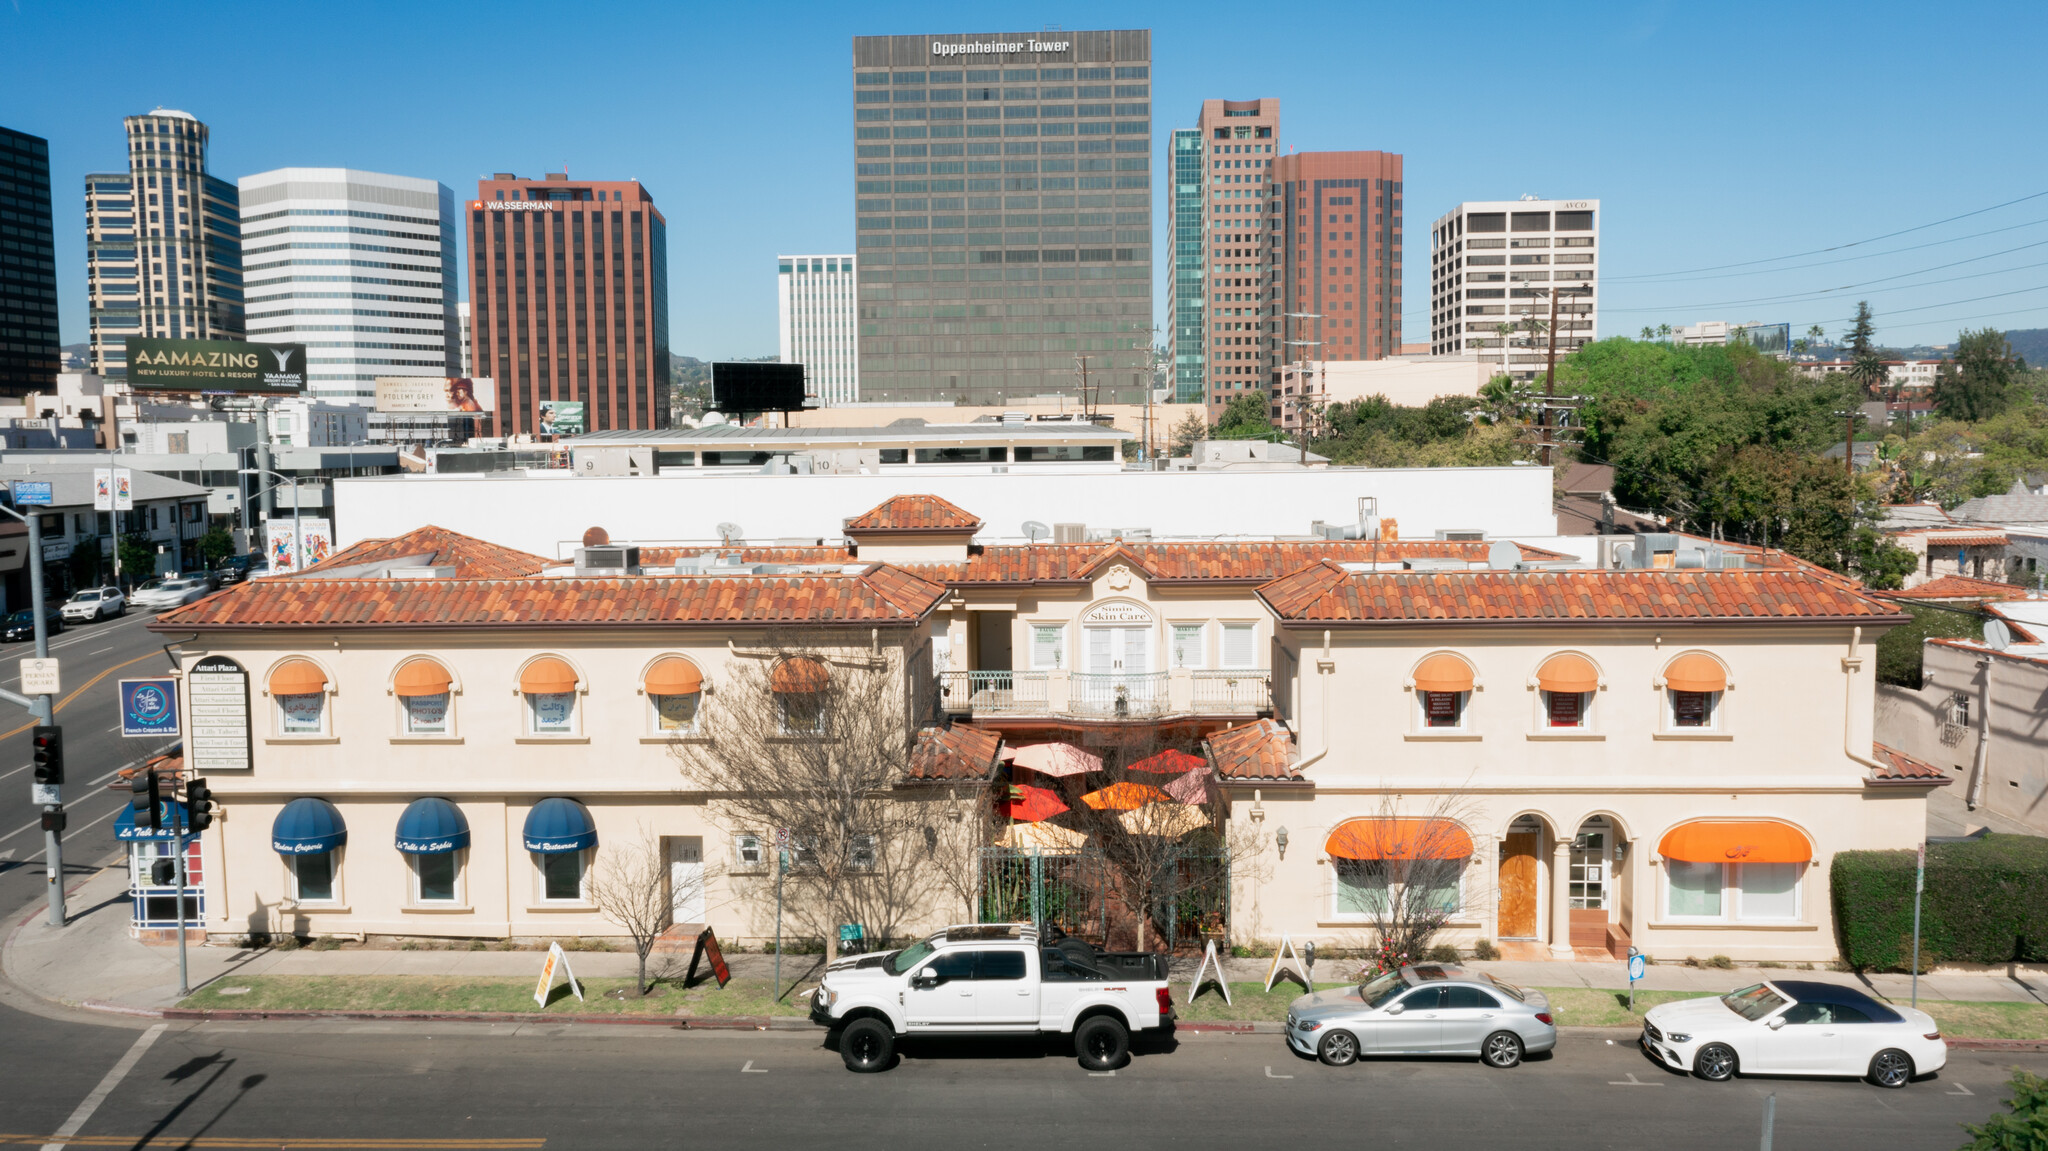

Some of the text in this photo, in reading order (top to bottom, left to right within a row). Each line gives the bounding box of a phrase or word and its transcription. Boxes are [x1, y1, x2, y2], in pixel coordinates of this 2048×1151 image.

[933, 40, 1069, 56] Oppenheimer Tower
[487, 202, 553, 210] WASSERMAN
[135, 350, 258, 368] AAMAZING
[586, 461, 593, 470] 9
[817, 461, 830, 470] 10
[119, 828, 132, 837] La
[134, 827, 153, 837] Tabl
[157, 828, 166, 836] de
[274, 841, 293, 850] Modern
[403, 842, 418, 850] Table
[429, 841, 452, 851] Sophie
[526, 840, 578, 850] French Restaurant
